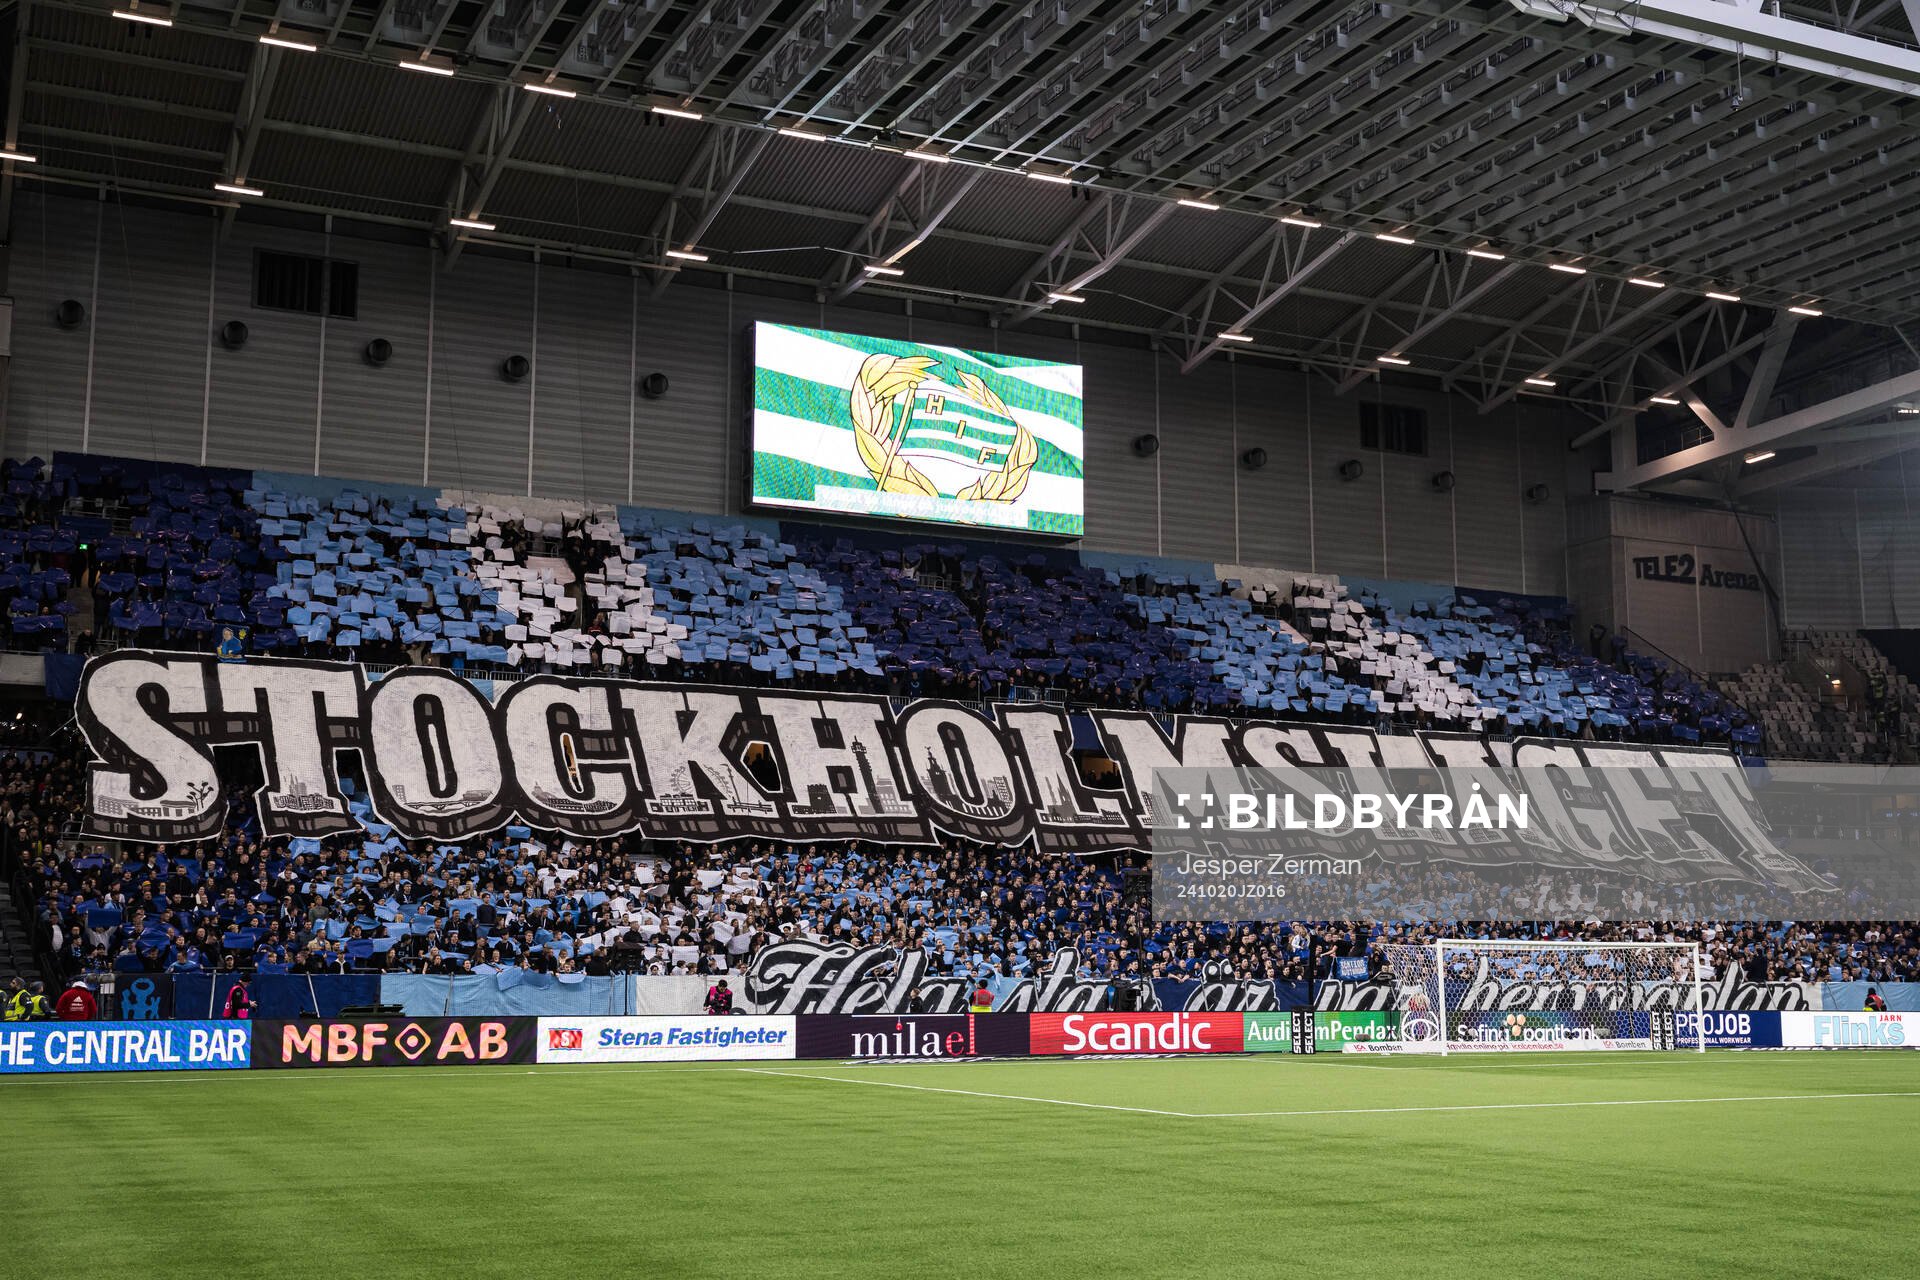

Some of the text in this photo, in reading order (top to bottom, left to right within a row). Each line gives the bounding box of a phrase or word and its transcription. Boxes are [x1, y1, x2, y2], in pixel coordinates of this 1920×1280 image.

[1632, 553, 1761, 591] TELE2 Arena
[281, 1022, 509, 1062] MBF AB
[597, 1026, 788, 1048] Stena Fastigheter
[851, 1013, 979, 1057] milael
[1063, 1012, 1212, 1051] Scandic
[1292, 1011, 1301, 1054] SELECT
[1304, 1011, 1314, 1054] SELECT
[1676, 1013, 1751, 1035] PROJOB
[1814, 1015, 1905, 1045] Flinks
[44, 1030, 180, 1064] CENTRAL
[189, 1028, 248, 1062] BAR
[1368, 1044, 1403, 1052] Bomben
[1616, 1041, 1646, 1049] Bomben
